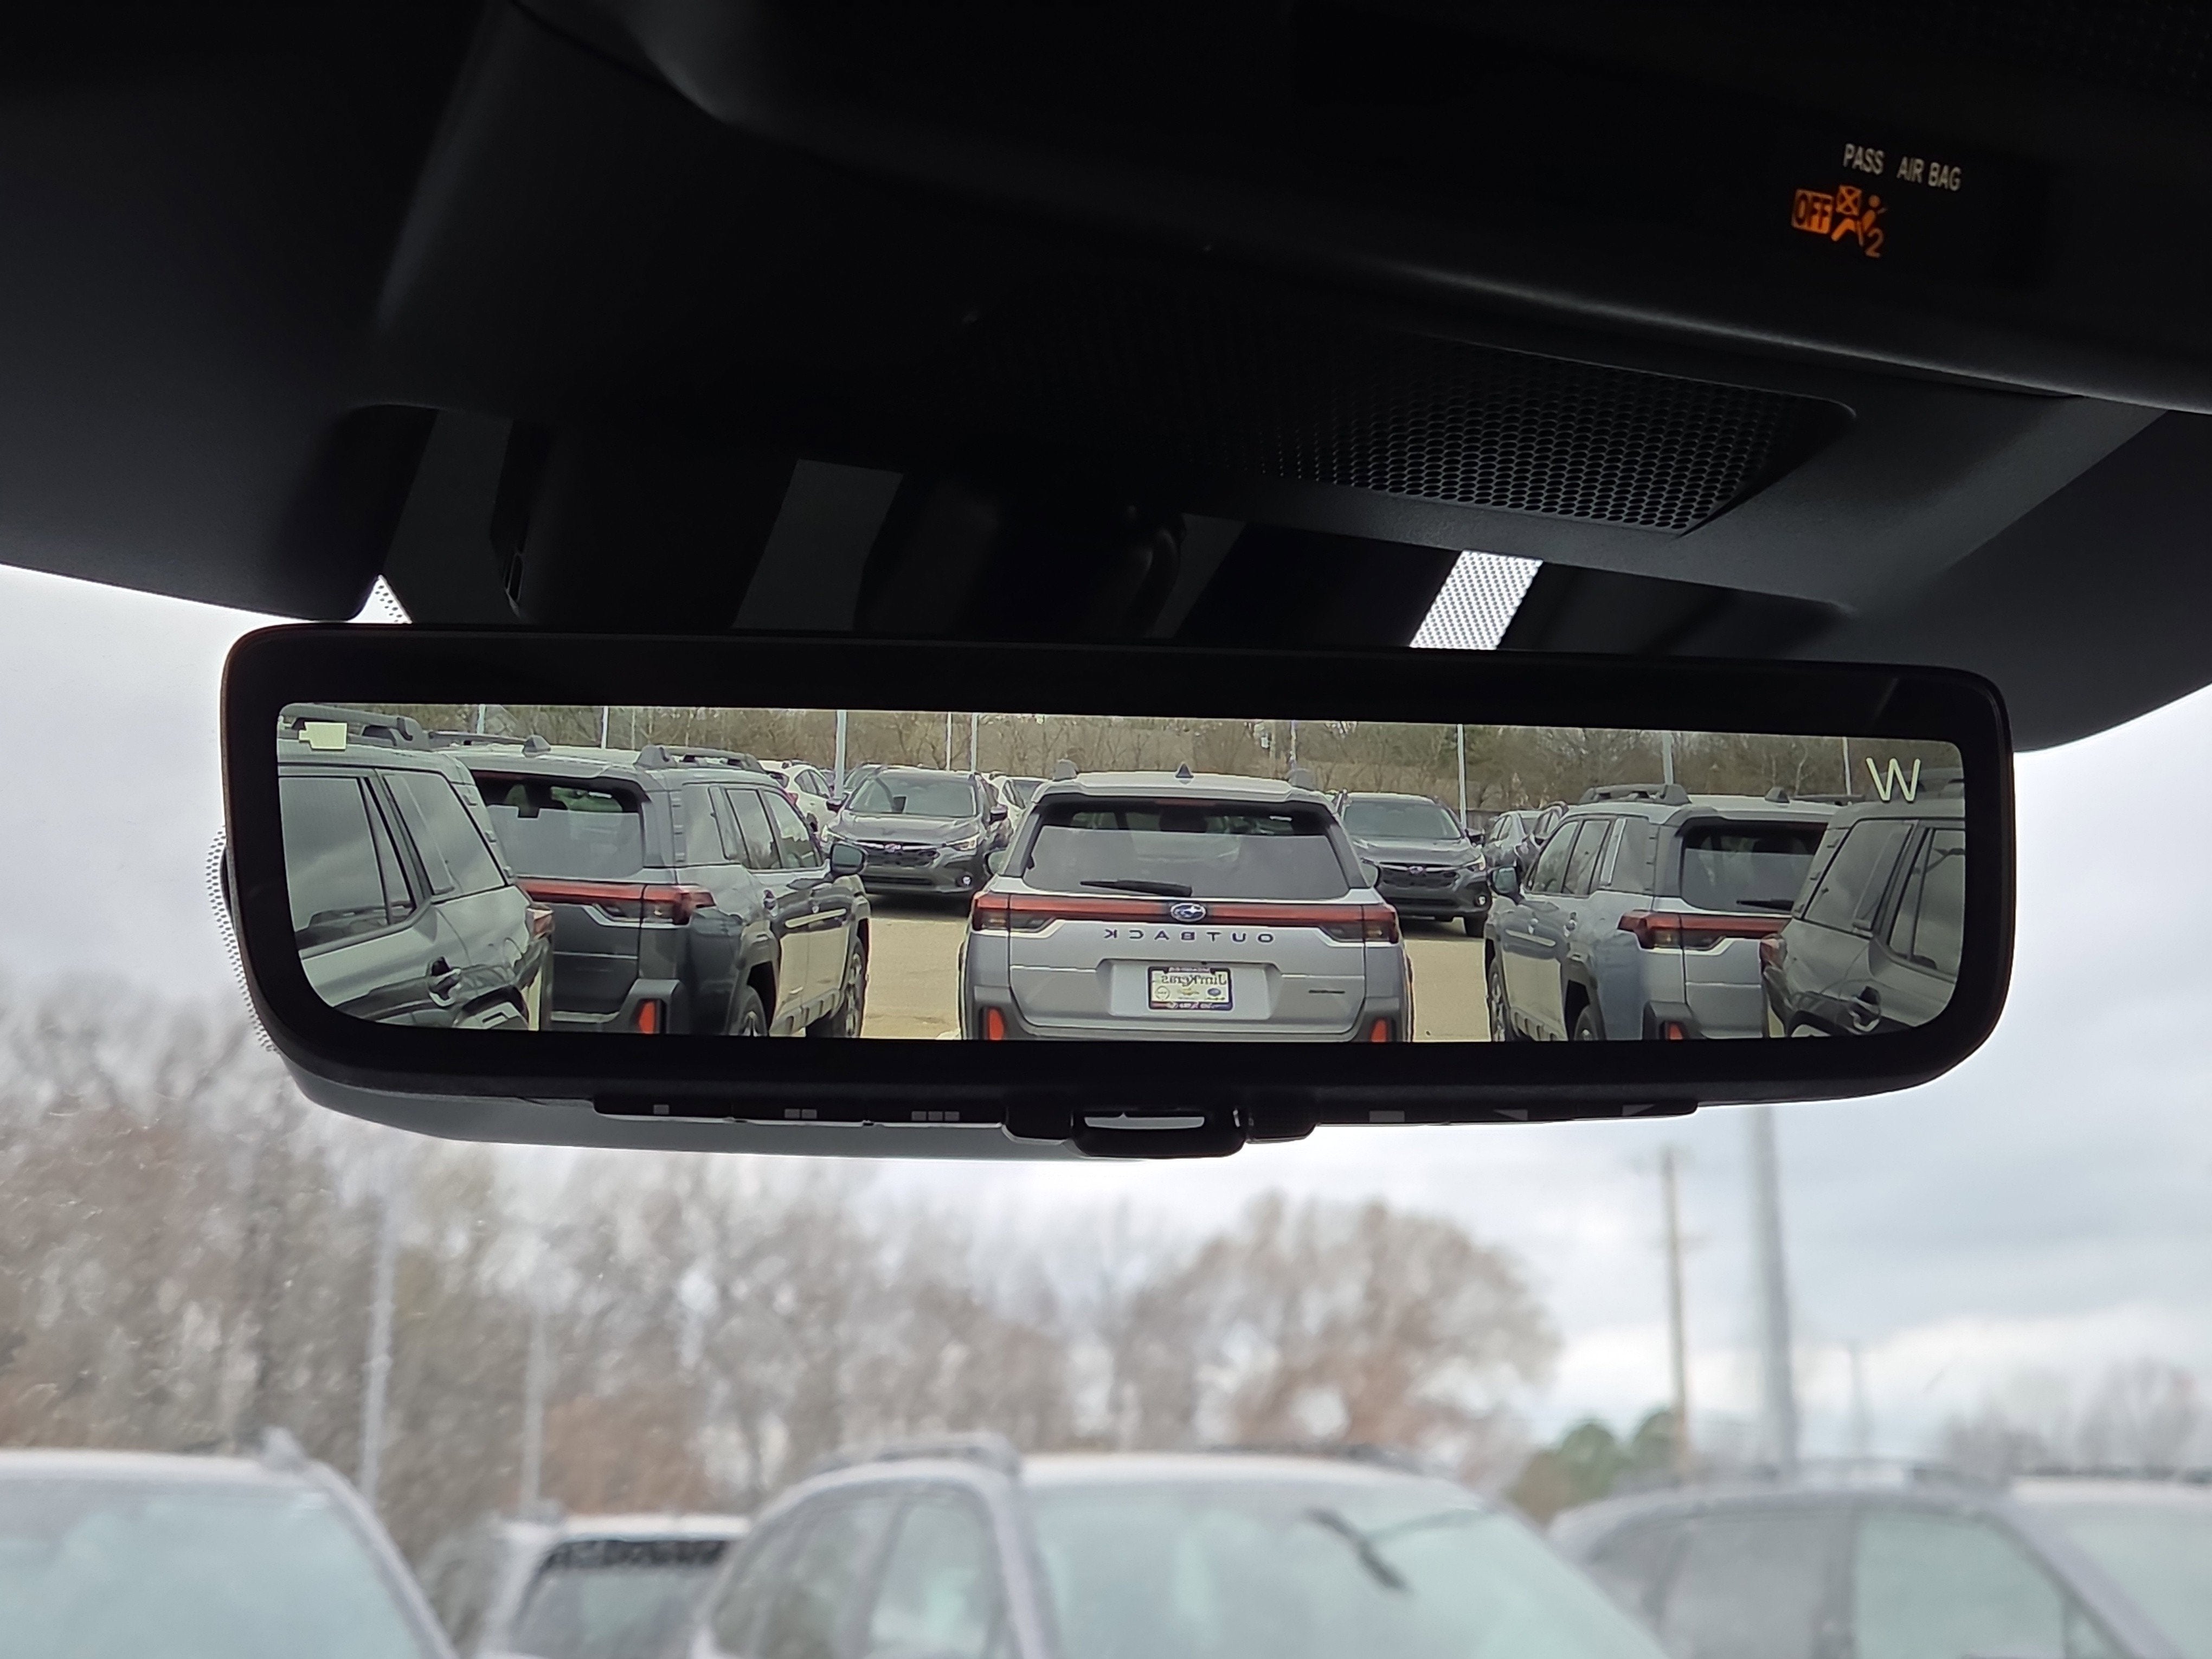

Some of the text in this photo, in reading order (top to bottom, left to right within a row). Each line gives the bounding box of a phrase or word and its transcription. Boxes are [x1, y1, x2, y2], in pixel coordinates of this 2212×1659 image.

[1843, 143, 1962, 191] PASS AIR BAG
[1794, 191, 1832, 232] OFF
[1865, 227, 1884, 258] 2
[1866, 757, 1921, 802] W
